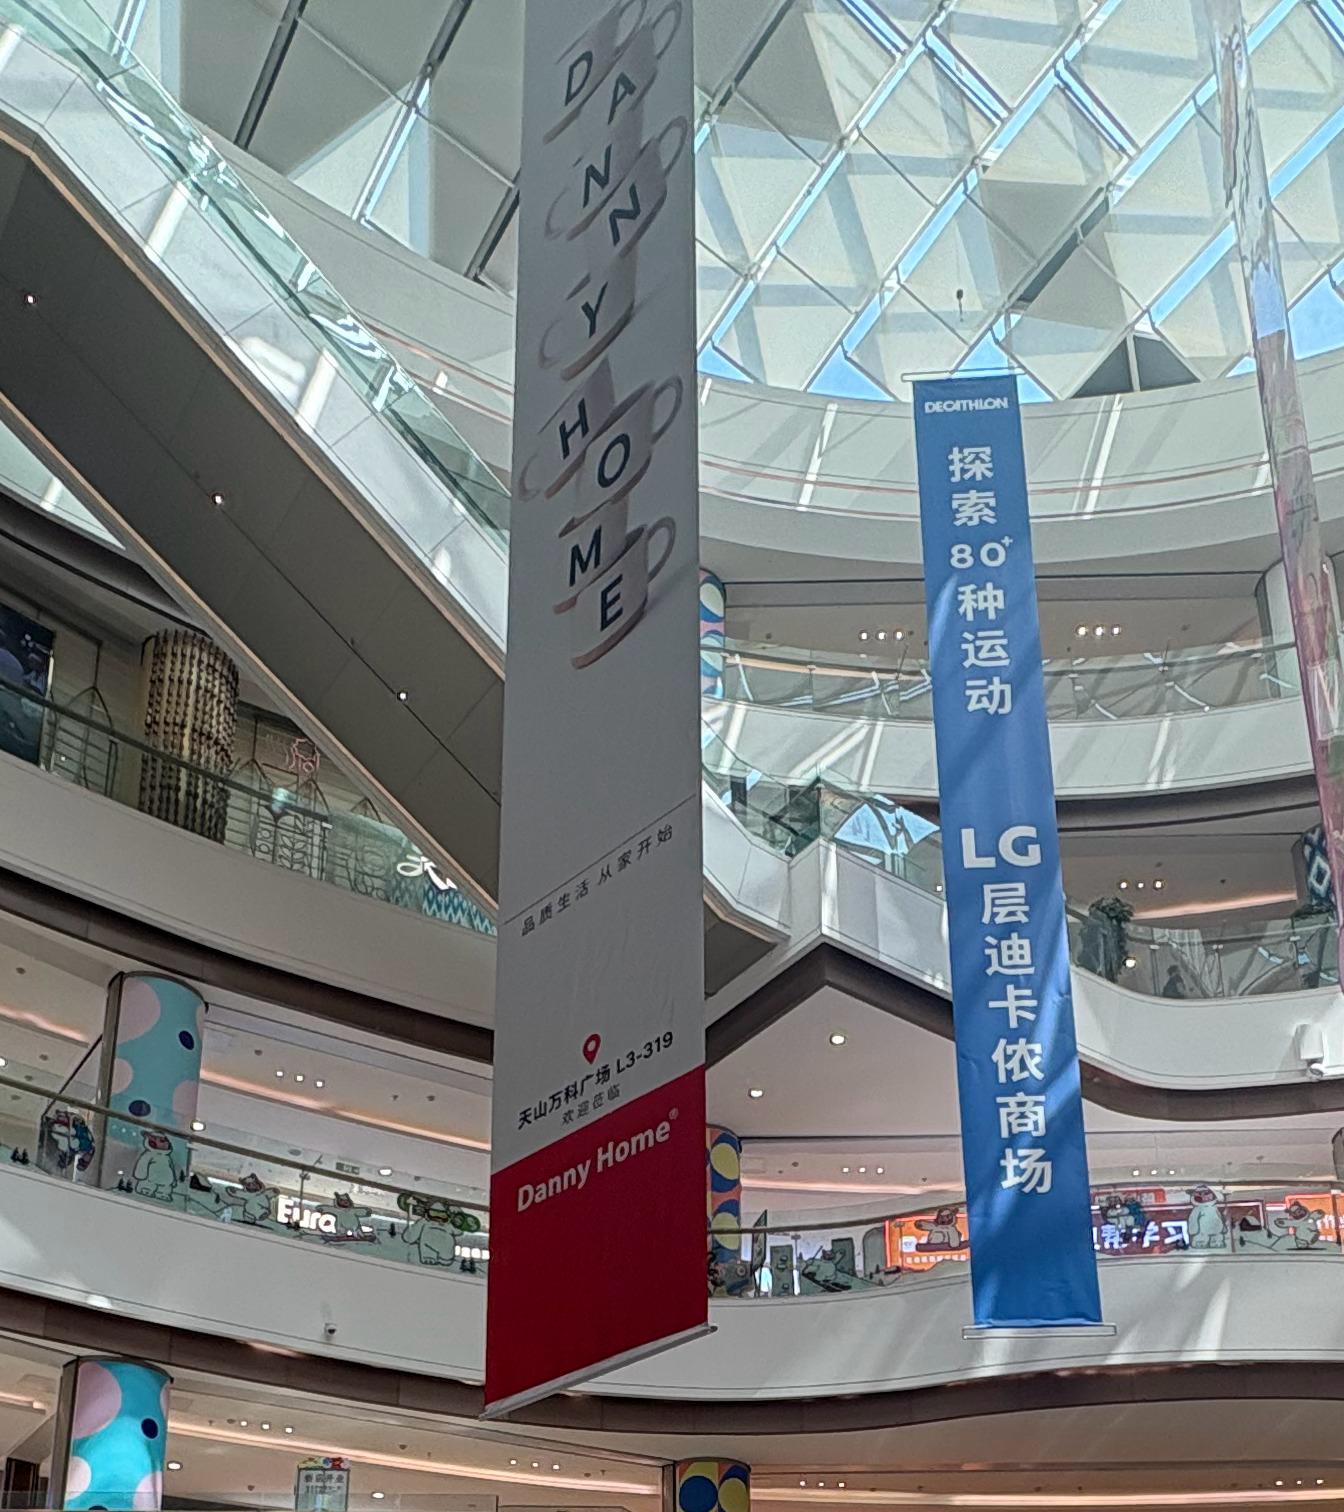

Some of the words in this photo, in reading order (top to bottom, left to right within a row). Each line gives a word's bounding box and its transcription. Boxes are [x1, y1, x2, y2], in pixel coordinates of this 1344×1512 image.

[924, 397, 1009, 414] DECATHLON
[518, 1064, 611, 1130] 天山万科广场
[616, 1031, 674, 1074] L3-319
[517, 1159, 591, 1212] Danny
[597, 1120, 671, 1173] Home
